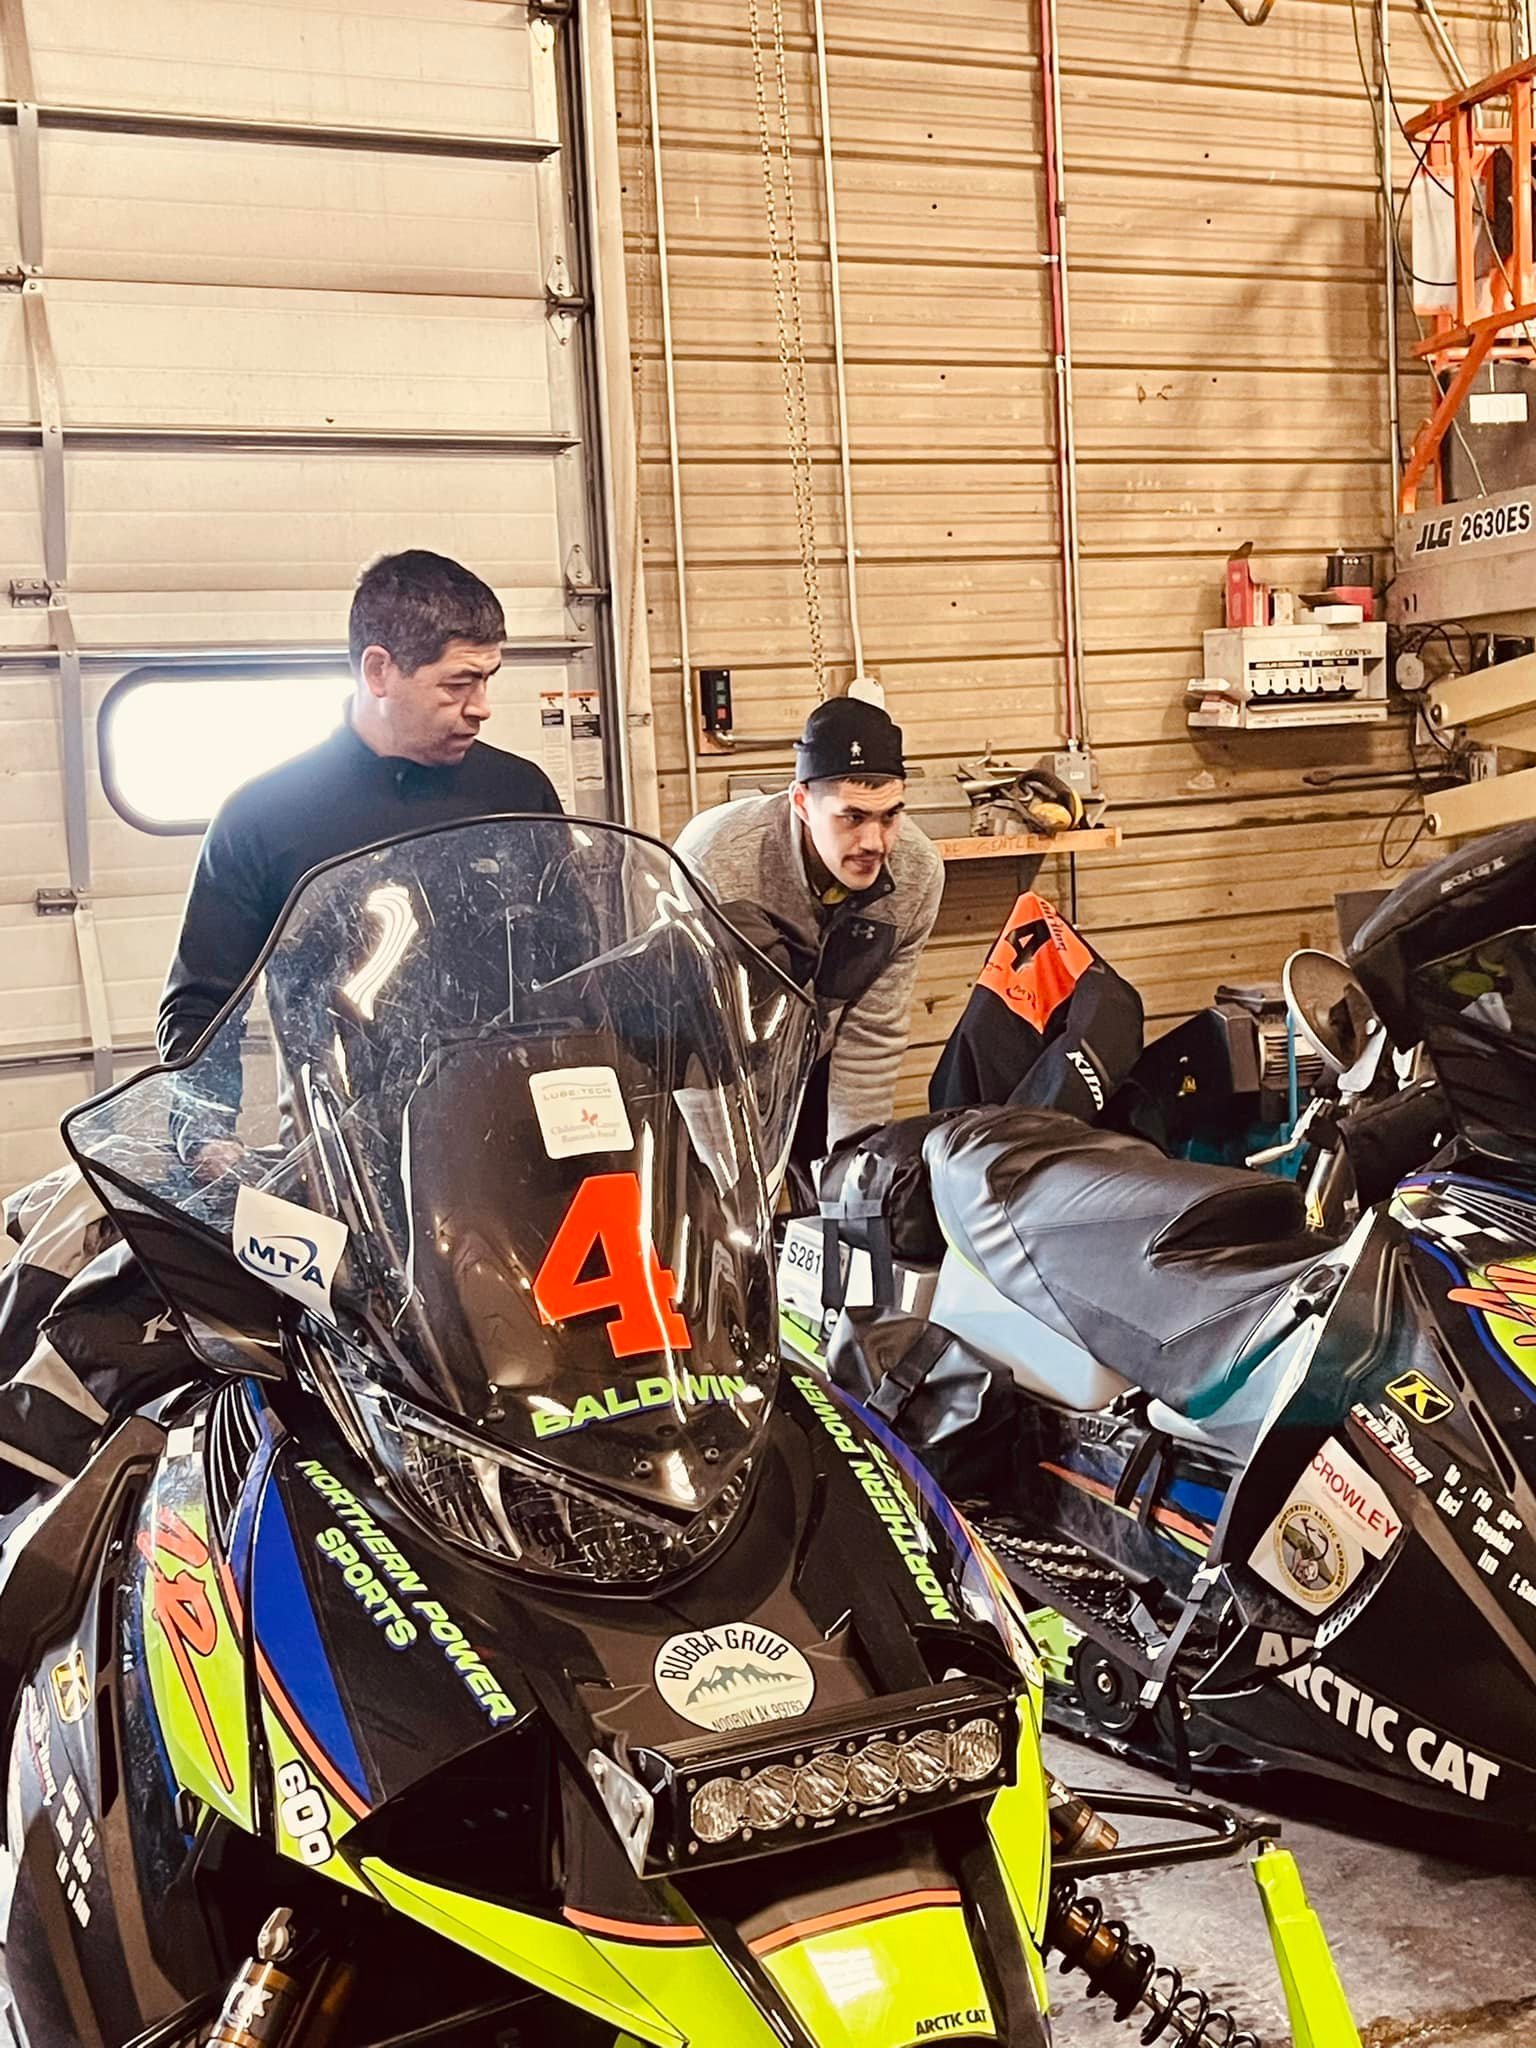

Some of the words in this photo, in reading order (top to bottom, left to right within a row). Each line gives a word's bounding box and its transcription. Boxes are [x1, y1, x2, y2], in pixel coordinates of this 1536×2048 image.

[1415, 520, 1453, 552] JLG
[1459, 503, 1531, 544] 2630ES
[1344, 648, 1373, 656] CENTER
[249, 1236, 326, 1290] MTA
[532, 1171, 692, 1359] 4
[533, 1375, 752, 1439] BALDWIN
[790, 1375, 865, 1454] POWER
[1311, 1451, 1399, 1539] CROWLEY
[848, 1459, 961, 1624] NORTHERN
[295, 1459, 428, 1597] NORTHERN
[412, 1600, 518, 1728] POWER
[314, 1526, 418, 1651] SPORTS
[660, 1633, 723, 1681] BUBBA
[725, 1628, 789, 1662] GRUB
[772, 1699, 806, 1718] 99763
[1255, 1631, 1400, 1754] ARCTIC
[1406, 1727, 1501, 1801] CAT
[277, 1761, 334, 1867] 600
[915, 2011, 964, 2036] ARCTIC
[966, 2009, 987, 2024] CAT
